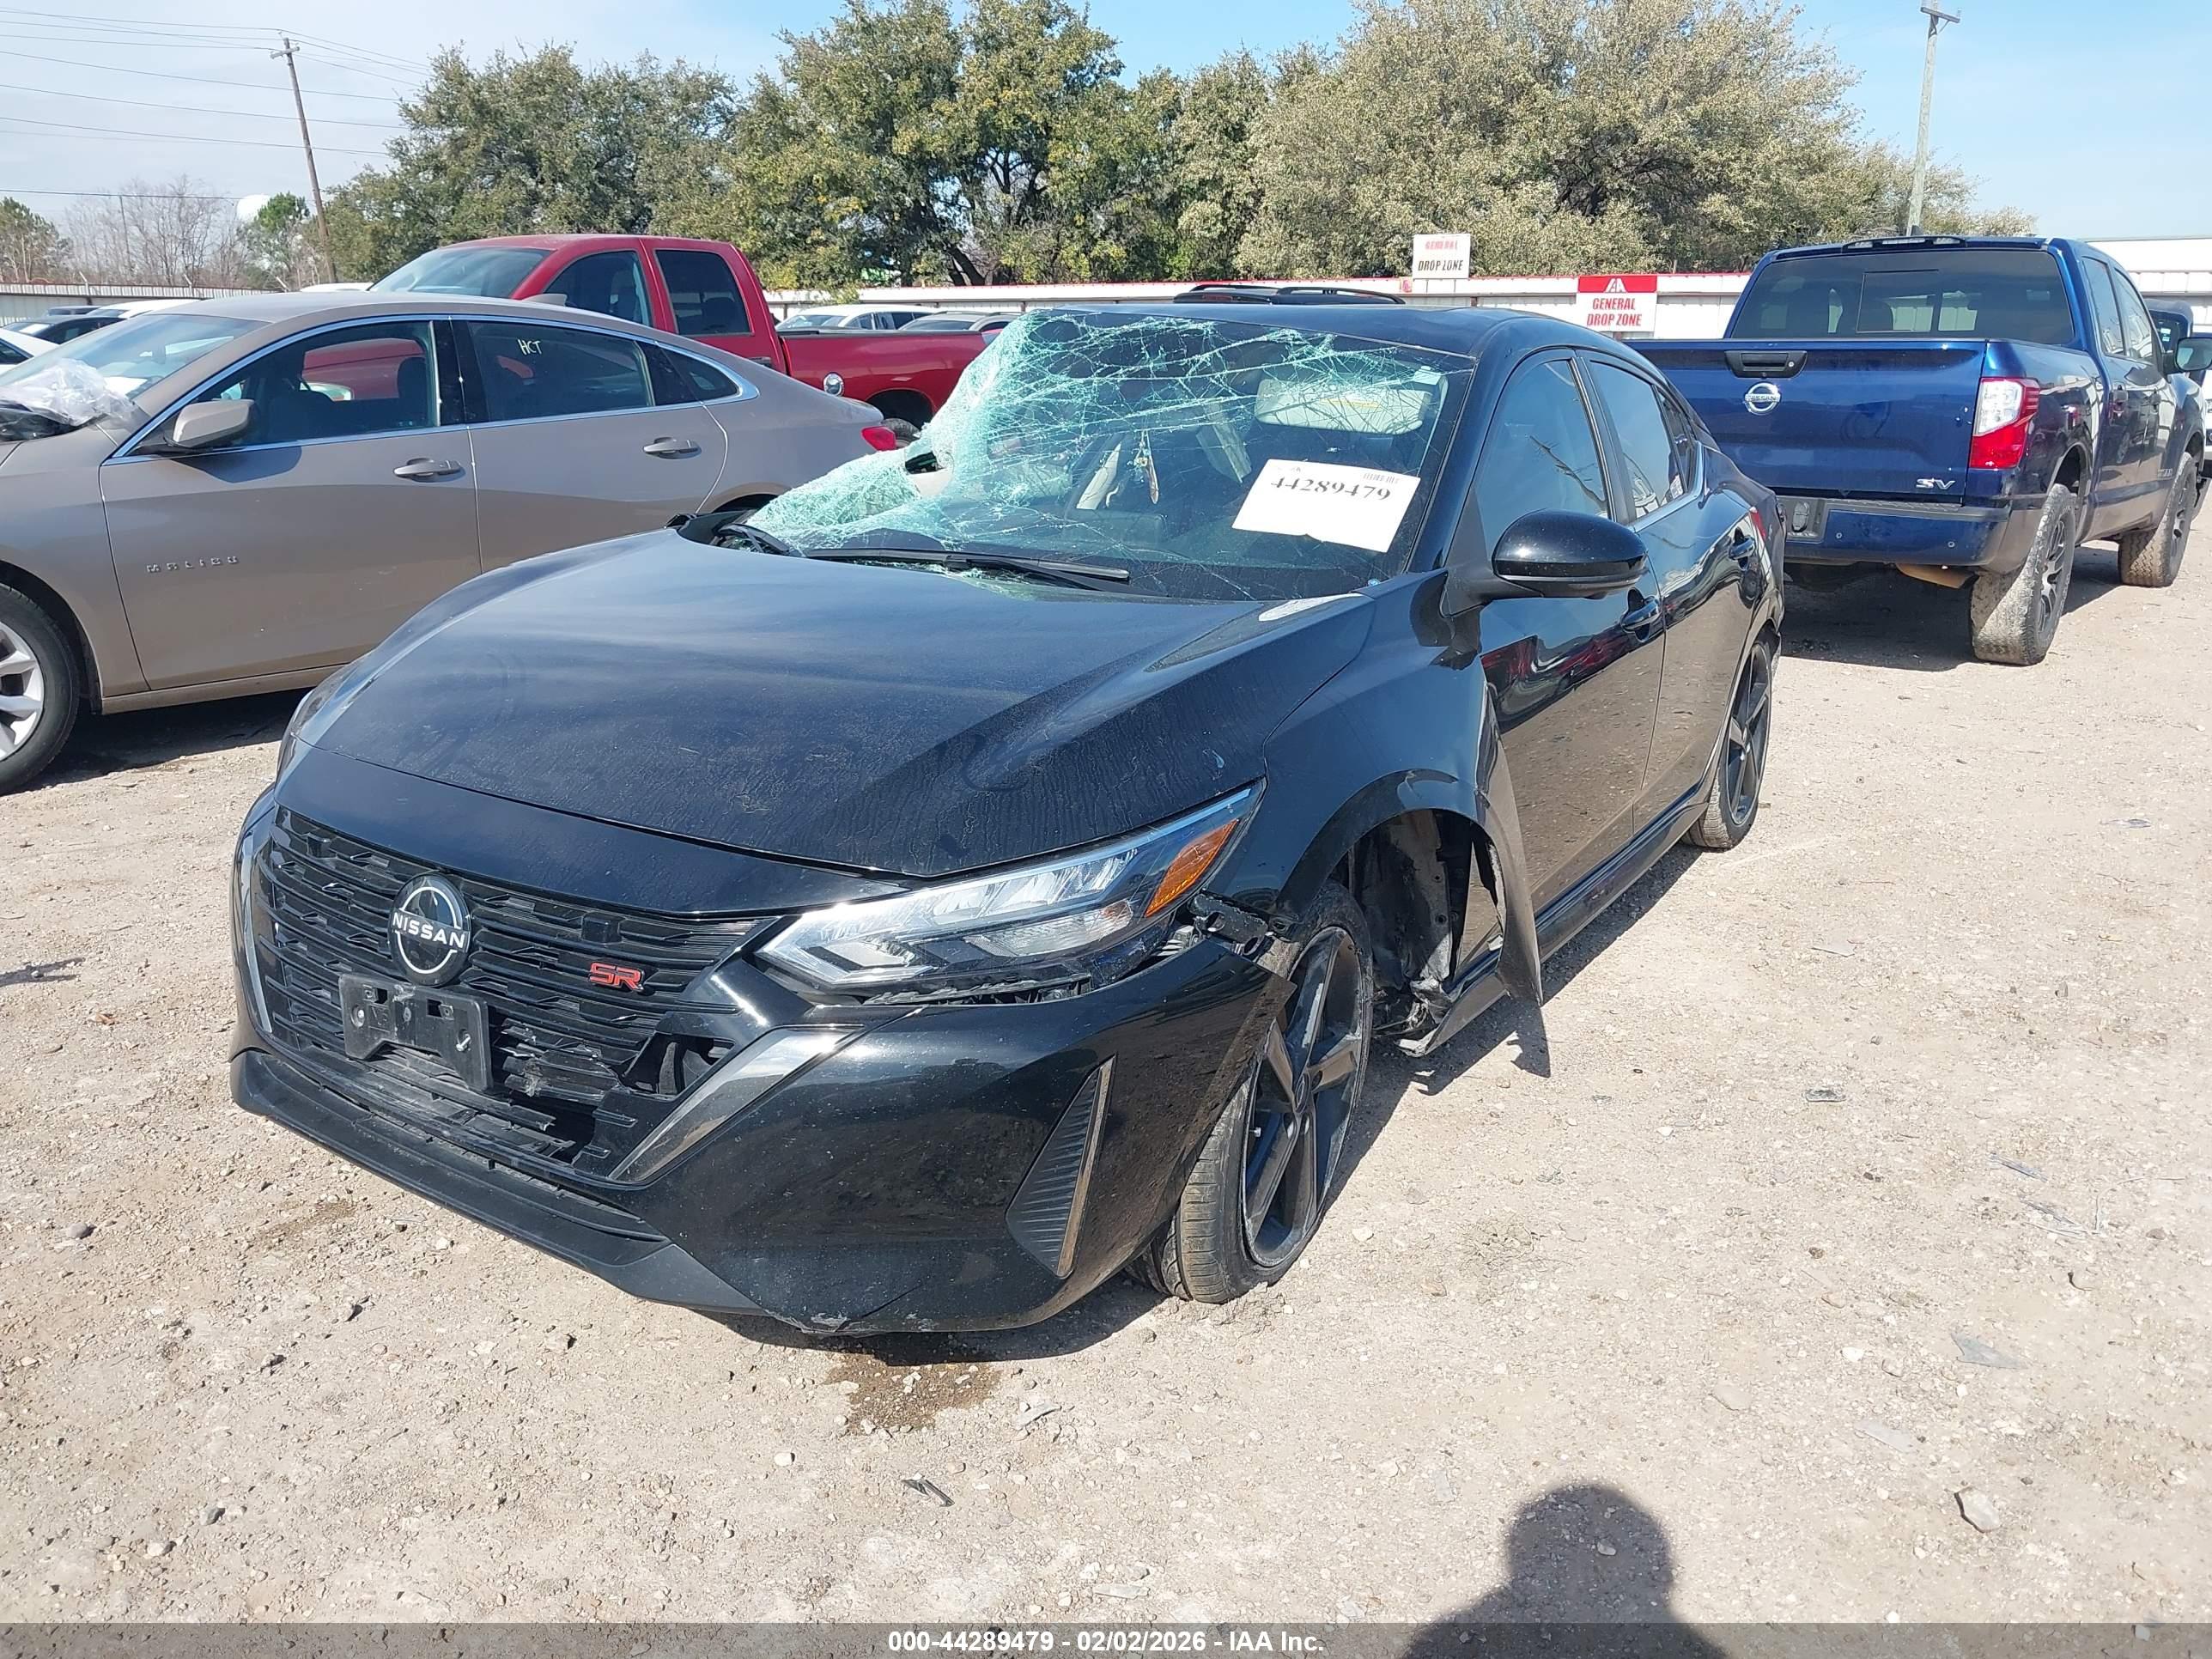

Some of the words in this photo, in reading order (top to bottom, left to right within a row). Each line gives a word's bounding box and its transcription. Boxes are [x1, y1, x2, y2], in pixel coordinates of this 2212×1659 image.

[1418, 259, 1441, 271] DROP
[1442, 258, 1464, 271] ZONE
[1592, 297, 1636, 310] GENERAL
[1586, 313, 1615, 326] DROP
[1615, 313, 1643, 326] ZONE
[517, 339, 543, 356] HCT
[1270, 476, 1391, 501] 44289479
[1916, 478, 1956, 490] SV
[146, 556, 238, 573] MALIBU
[392, 912, 465, 949] NISSAN
[589, 962, 642, 990] SR
